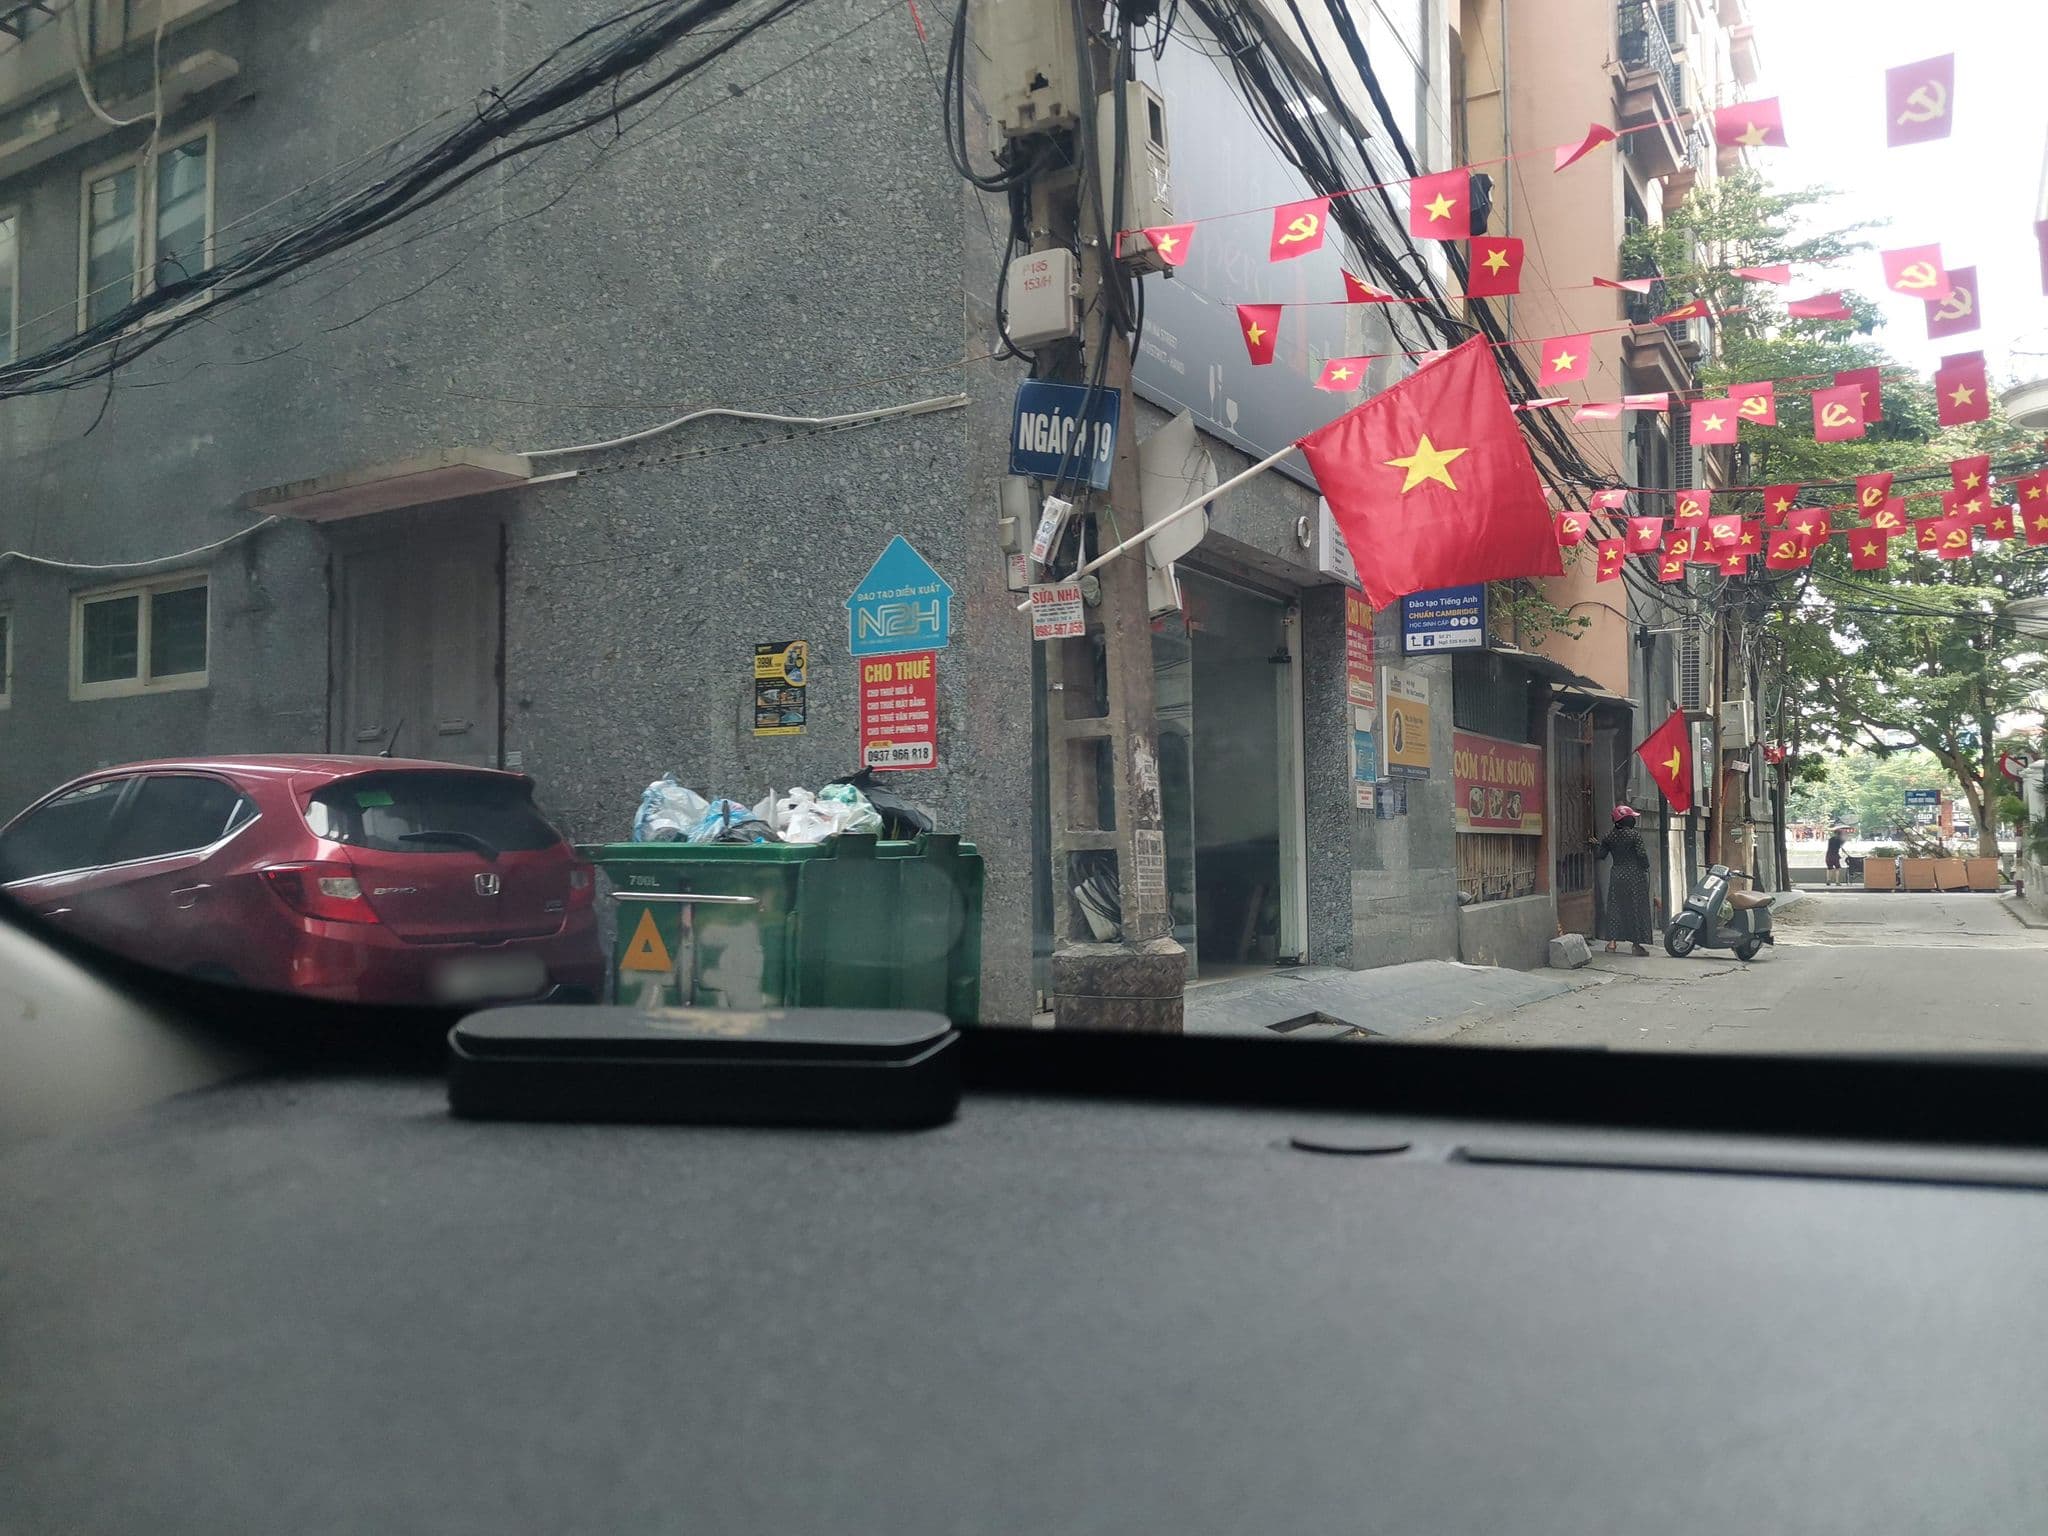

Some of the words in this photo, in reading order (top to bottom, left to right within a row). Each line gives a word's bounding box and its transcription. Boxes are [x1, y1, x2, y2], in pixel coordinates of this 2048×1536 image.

[1440, 596, 1461, 607] Tiếng
[1462, 596, 1478, 604] Anh
[1435, 608, 1480, 618] CAMBRIDGE
[864, 663, 893, 683] CHO
[895, 656, 931, 680] THUÊ
[868, 751, 890, 762] 0937
[1454, 746, 1479, 780] CƠM
[1507, 754, 1535, 788] SƯỜN
